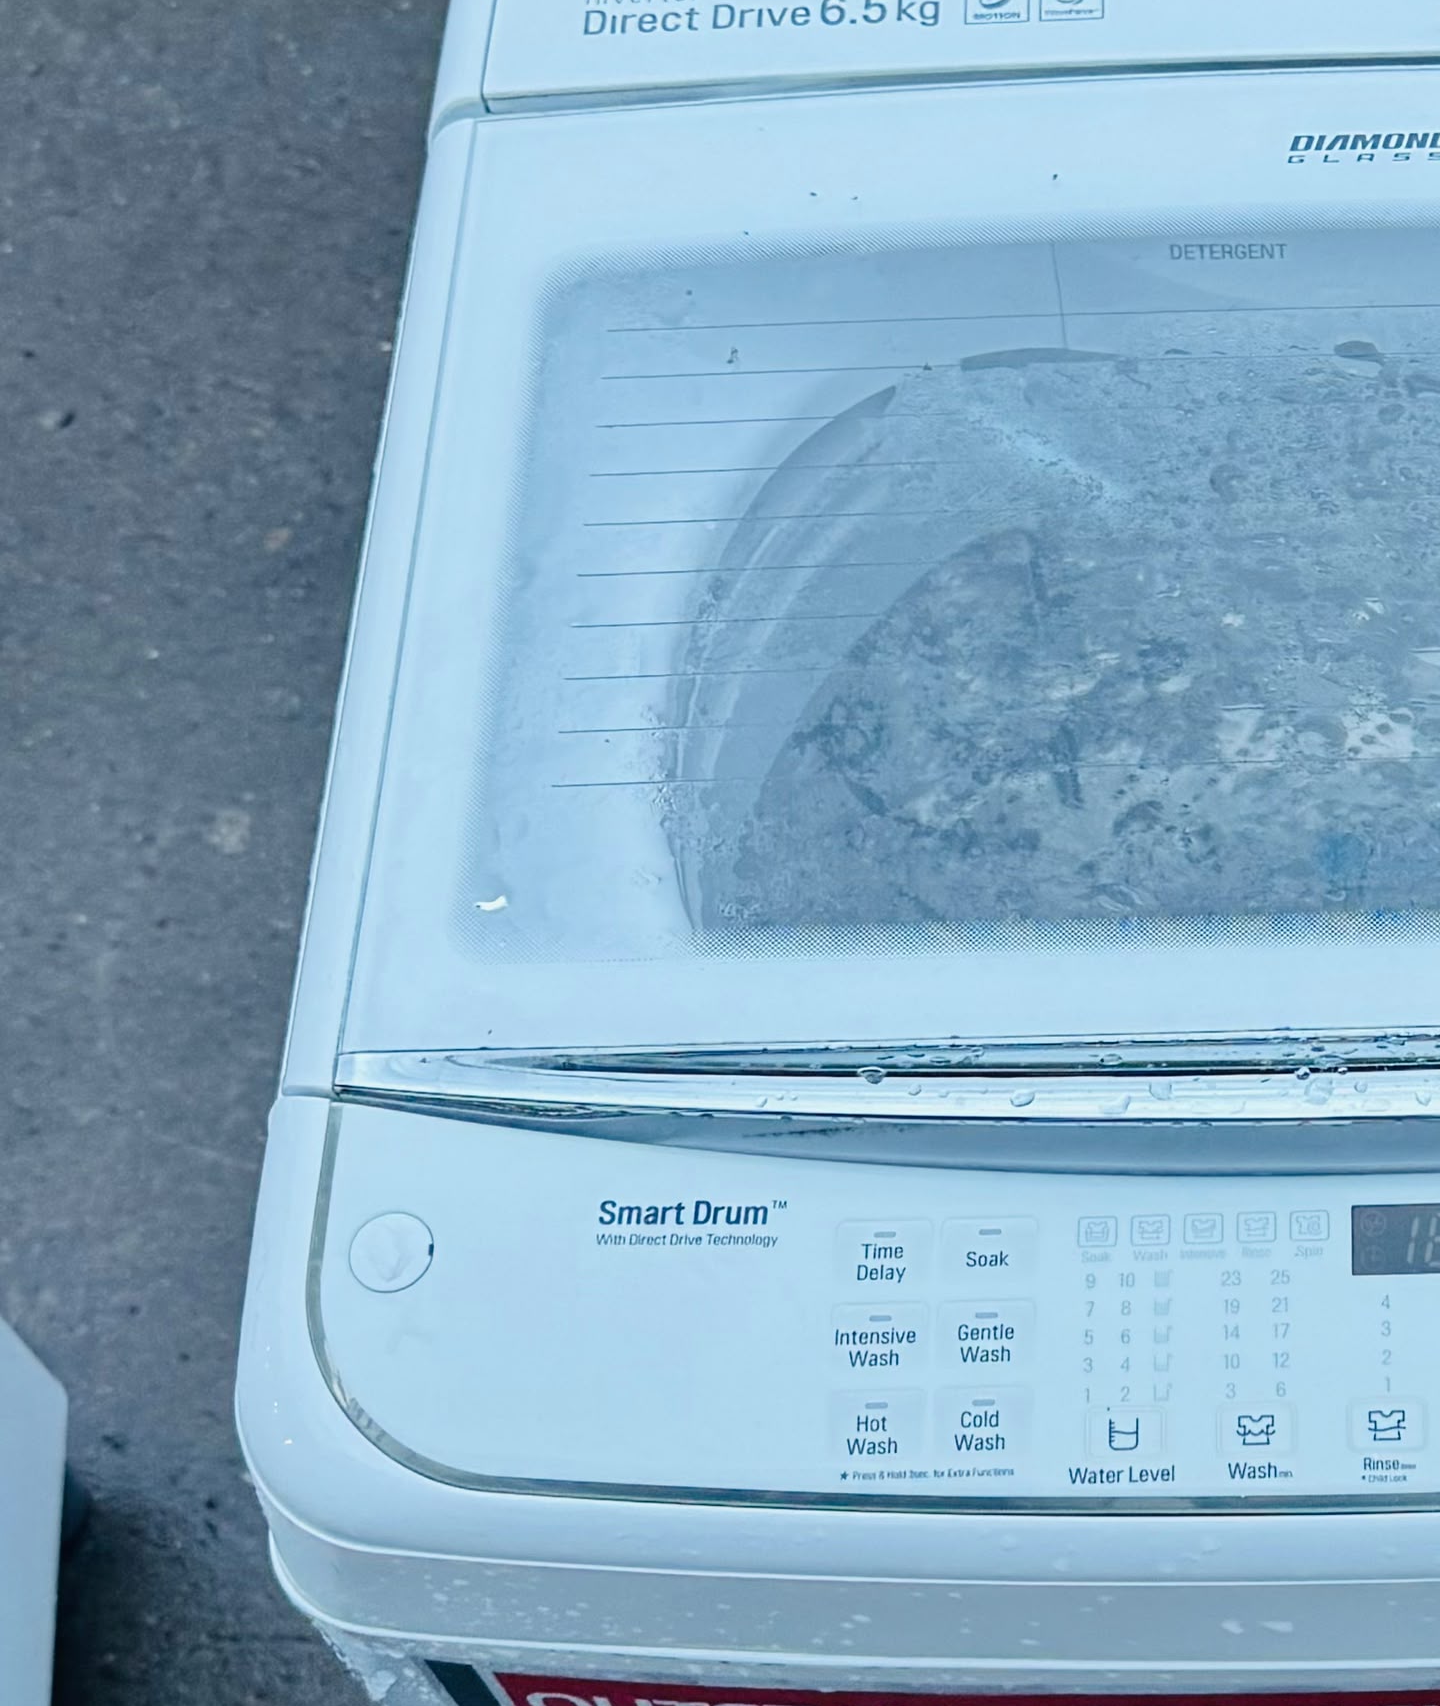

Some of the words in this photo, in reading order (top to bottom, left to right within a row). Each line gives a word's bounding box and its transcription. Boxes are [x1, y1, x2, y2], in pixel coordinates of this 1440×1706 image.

[583, 6, 699, 35] Direct
[712, 1, 811, 30] Drive
[1170, 243, 1287, 260] DETERGENT
[599, 1200, 685, 1225] Smart
[596, 1234, 625, 1245] With
[629, 1234, 666, 1245] Direct
[670, 1234, 702, 1245] Drive
[707, 1234, 778, 1247] Technology
[862, 1244, 904, 1260] Time
[966, 1251, 1009, 1267] Soak
[1081, 1251, 1111, 1263] Soak
[1132, 1250, 1168, 1262] Wash
[857, 1264, 906, 1282] Delay
[1086, 1274, 1096, 1288] 9
[1119, 1273, 1135, 1287] 10
[1221, 1271, 1241, 1285] 23
[1271, 1270, 1290, 1285] 25
[1086, 1301, 1095, 1317] 7
[1121, 1301, 1131, 1315] 8
[1224, 1299, 1240, 1314] 19
[1272, 1297, 1289, 1312] 21
[1381, 1294, 1390, 1309] 4
[834, 1329, 916, 1346] Intensive
[957, 1324, 1014, 1341] Gentle
[1084, 1329, 1093, 1345] 5
[1121, 1329, 1130, 1344] 6
[1223, 1325, 1240, 1340] 14
[1273, 1323, 1290, 1339] 17
[1381, 1322, 1391, 1337] 3
[848, 1351, 899, 1367] Wash
[960, 1346, 1011, 1363] Wash
[1224, 1354, 1240, 1369] 10
[1273, 1353, 1290, 1368] 12
[1381, 1350, 1391, 1365] 2
[1083, 1357, 1093, 1373] 3
[1120, 1357, 1130, 1372] 4
[1225, 1383, 1236, 1398] 3
[1276, 1382, 1286, 1396] 6
[1384, 1377, 1391, 1392] 1
[1120, 1386, 1130, 1402] 2
[856, 1416, 887, 1432] Hot
[960, 1411, 999, 1428] Cold
[847, 1439, 898, 1455] Wash
[954, 1434, 1005, 1451] Wash
[1228, 1462, 1278, 1479] Wash
[1363, 1457, 1399, 1471] Rinse
[1069, 1467, 1124, 1485] Water
[1128, 1464, 1175, 1483] Level
